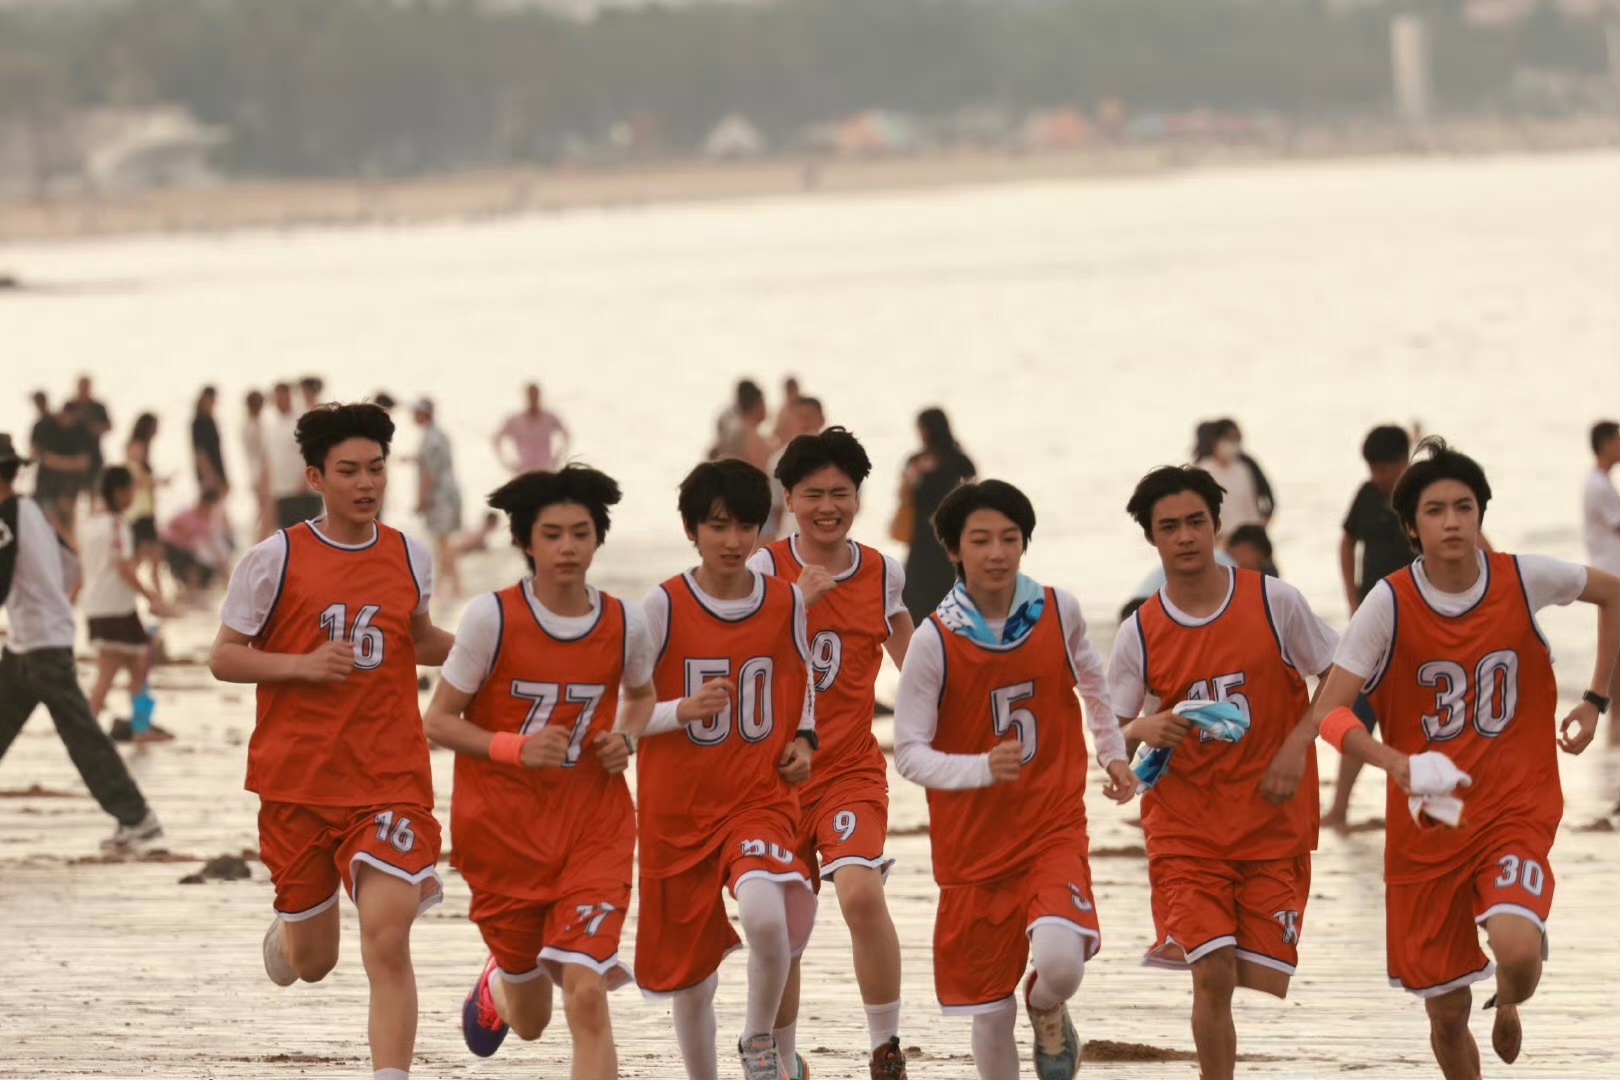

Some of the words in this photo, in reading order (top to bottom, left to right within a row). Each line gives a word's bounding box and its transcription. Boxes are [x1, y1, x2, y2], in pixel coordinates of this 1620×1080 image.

[319, 602, 385, 671] 16
[810, 629, 843, 692] 9
[510, 678, 607, 769] 77
[684, 656, 774, 746] 50
[990, 680, 1038, 767] 5
[1416, 648, 1519, 742] 30
[374, 810, 416, 853] 16
[834, 810, 858, 843] 9
[1495, 853, 1545, 898] 30
